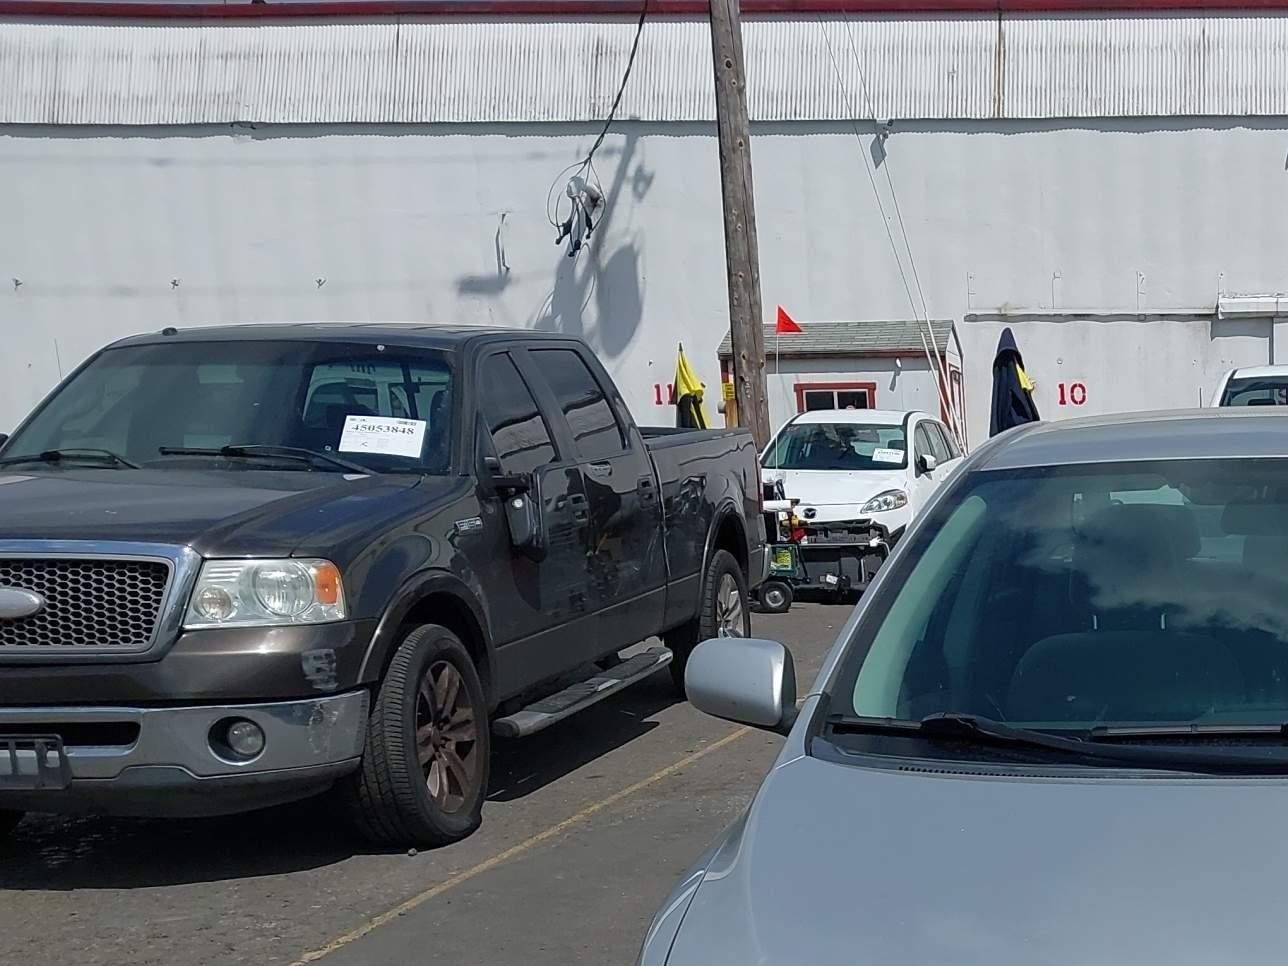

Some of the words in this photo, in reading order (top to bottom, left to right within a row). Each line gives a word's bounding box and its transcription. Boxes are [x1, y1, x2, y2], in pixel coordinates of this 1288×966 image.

[654, 383, 677, 405] 11
[1058, 383, 1086, 405] 10
[352, 424, 414, 435] 45053848
